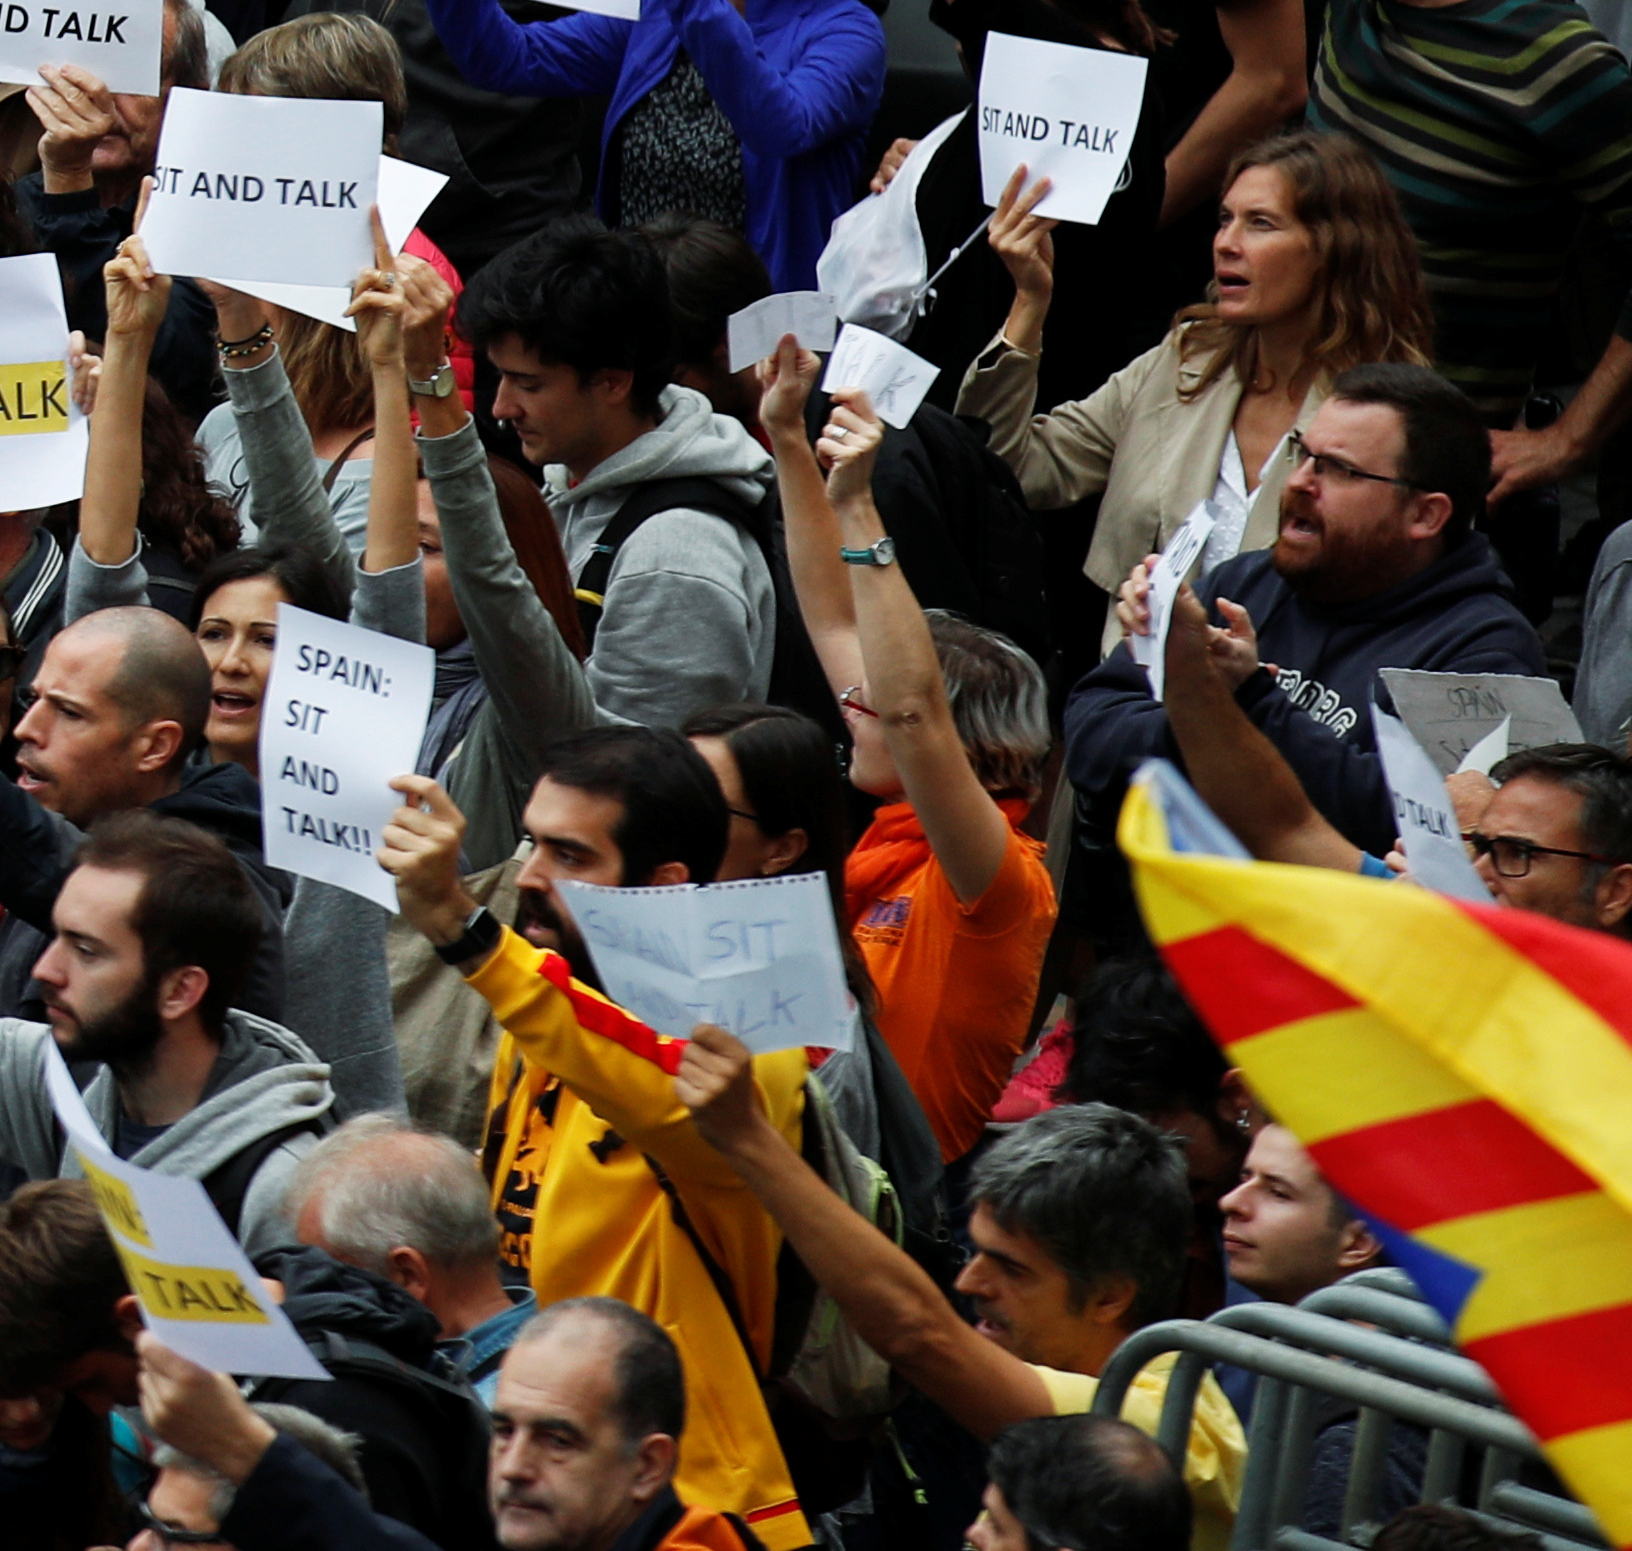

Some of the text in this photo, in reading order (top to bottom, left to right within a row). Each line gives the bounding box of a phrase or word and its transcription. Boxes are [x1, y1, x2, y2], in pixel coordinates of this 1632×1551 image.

[40, 8, 129, 45] TALK
[982, 105, 1118, 153] SIT AND TALK
[191, 171, 266, 203] AND
[277, 176, 359, 210] TALK
[296, 644, 392, 697] SPAIN:
[284, 698, 330, 736] SIT
[281, 754, 339, 797] AND
[282, 806, 372, 856] TALK!!
[708, 918, 789, 962] SIT
[144, 1270, 265, 1313] TALK
